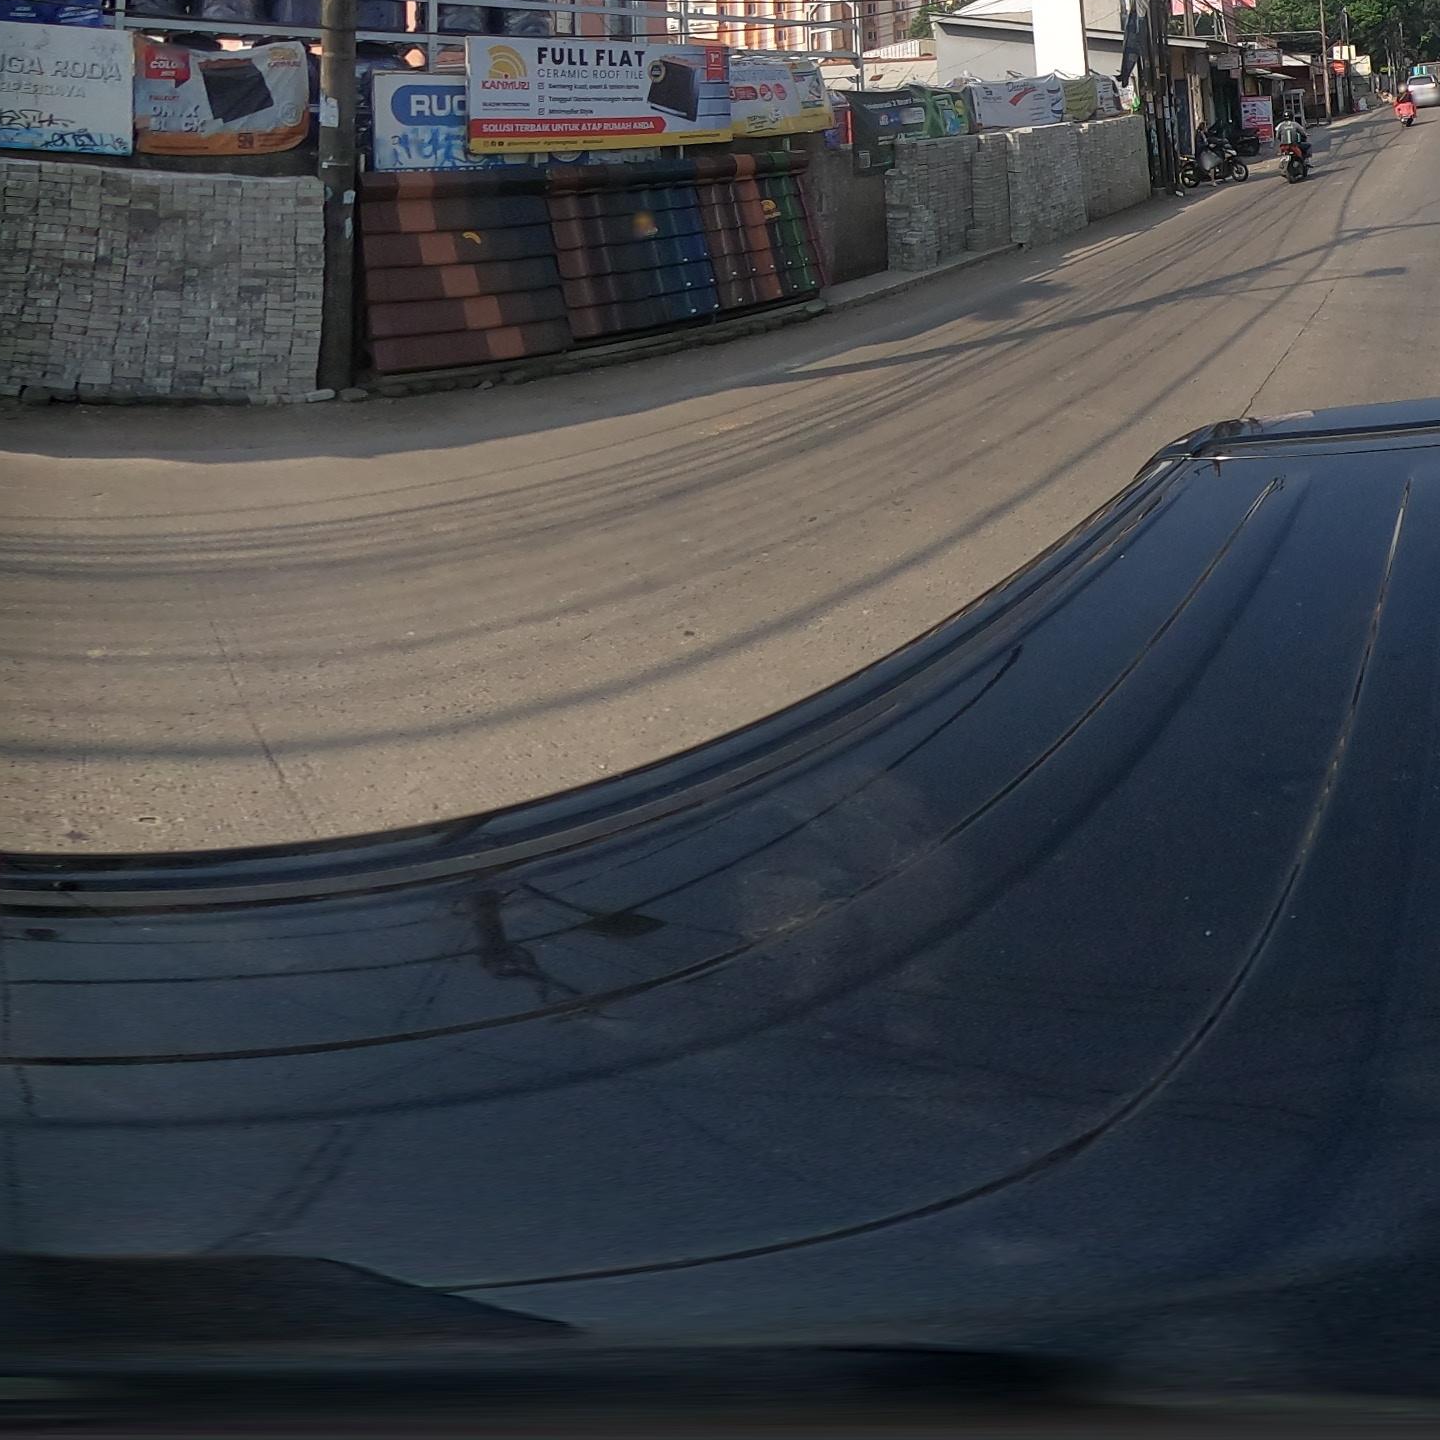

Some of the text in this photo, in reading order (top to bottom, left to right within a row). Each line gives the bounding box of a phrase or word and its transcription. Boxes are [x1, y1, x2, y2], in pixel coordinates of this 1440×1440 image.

[537, 47, 645, 67] FULL FLAT
[50, 59, 123, 83] RODA
[537, 68, 644, 80] CERAMIC ROOF TILE
[481, 80, 530, 90] KANMURI
[482, 123, 513, 132] SOLUSI
[514, 123, 551, 132] TERBAIK
[552, 123, 579, 132] UNTUK
[632, 121, 654, 130] ANDA
